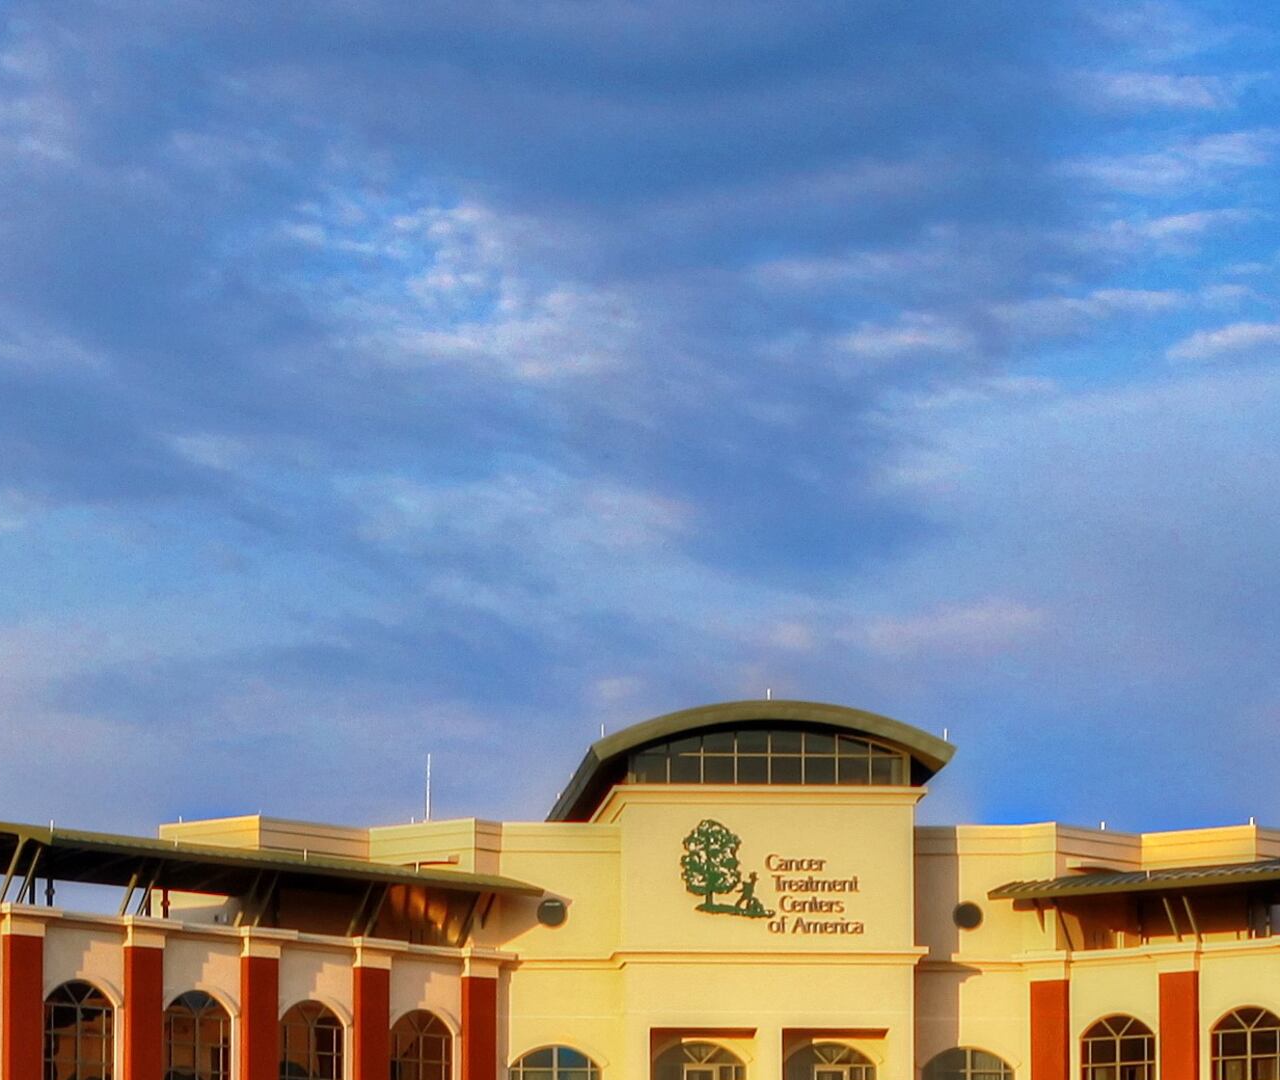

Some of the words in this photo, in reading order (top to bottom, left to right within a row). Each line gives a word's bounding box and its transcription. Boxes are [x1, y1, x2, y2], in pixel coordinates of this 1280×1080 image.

[765, 854, 826, 872] Cancer
[771, 875, 859, 893] Treatment
[779, 895, 845, 913] Centers
[768, 916, 788, 934] of
[792, 916, 864, 934] America
